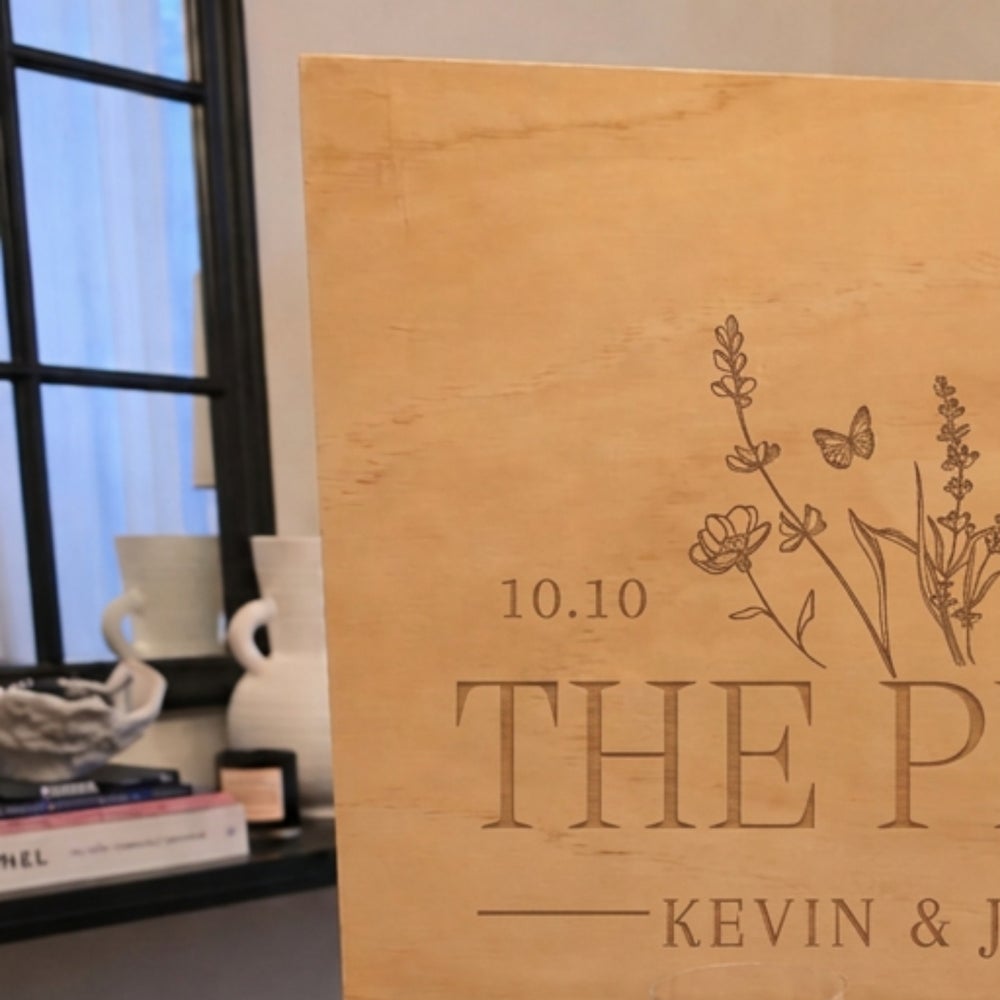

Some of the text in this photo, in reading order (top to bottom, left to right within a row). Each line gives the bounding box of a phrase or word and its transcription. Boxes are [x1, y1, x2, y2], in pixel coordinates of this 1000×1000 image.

[502, 577, 647, 619] 10.10
[456, 681, 815, 830] THE
[662, 897, 875, 949] KEVIN
[909, 897, 951, 949] &
